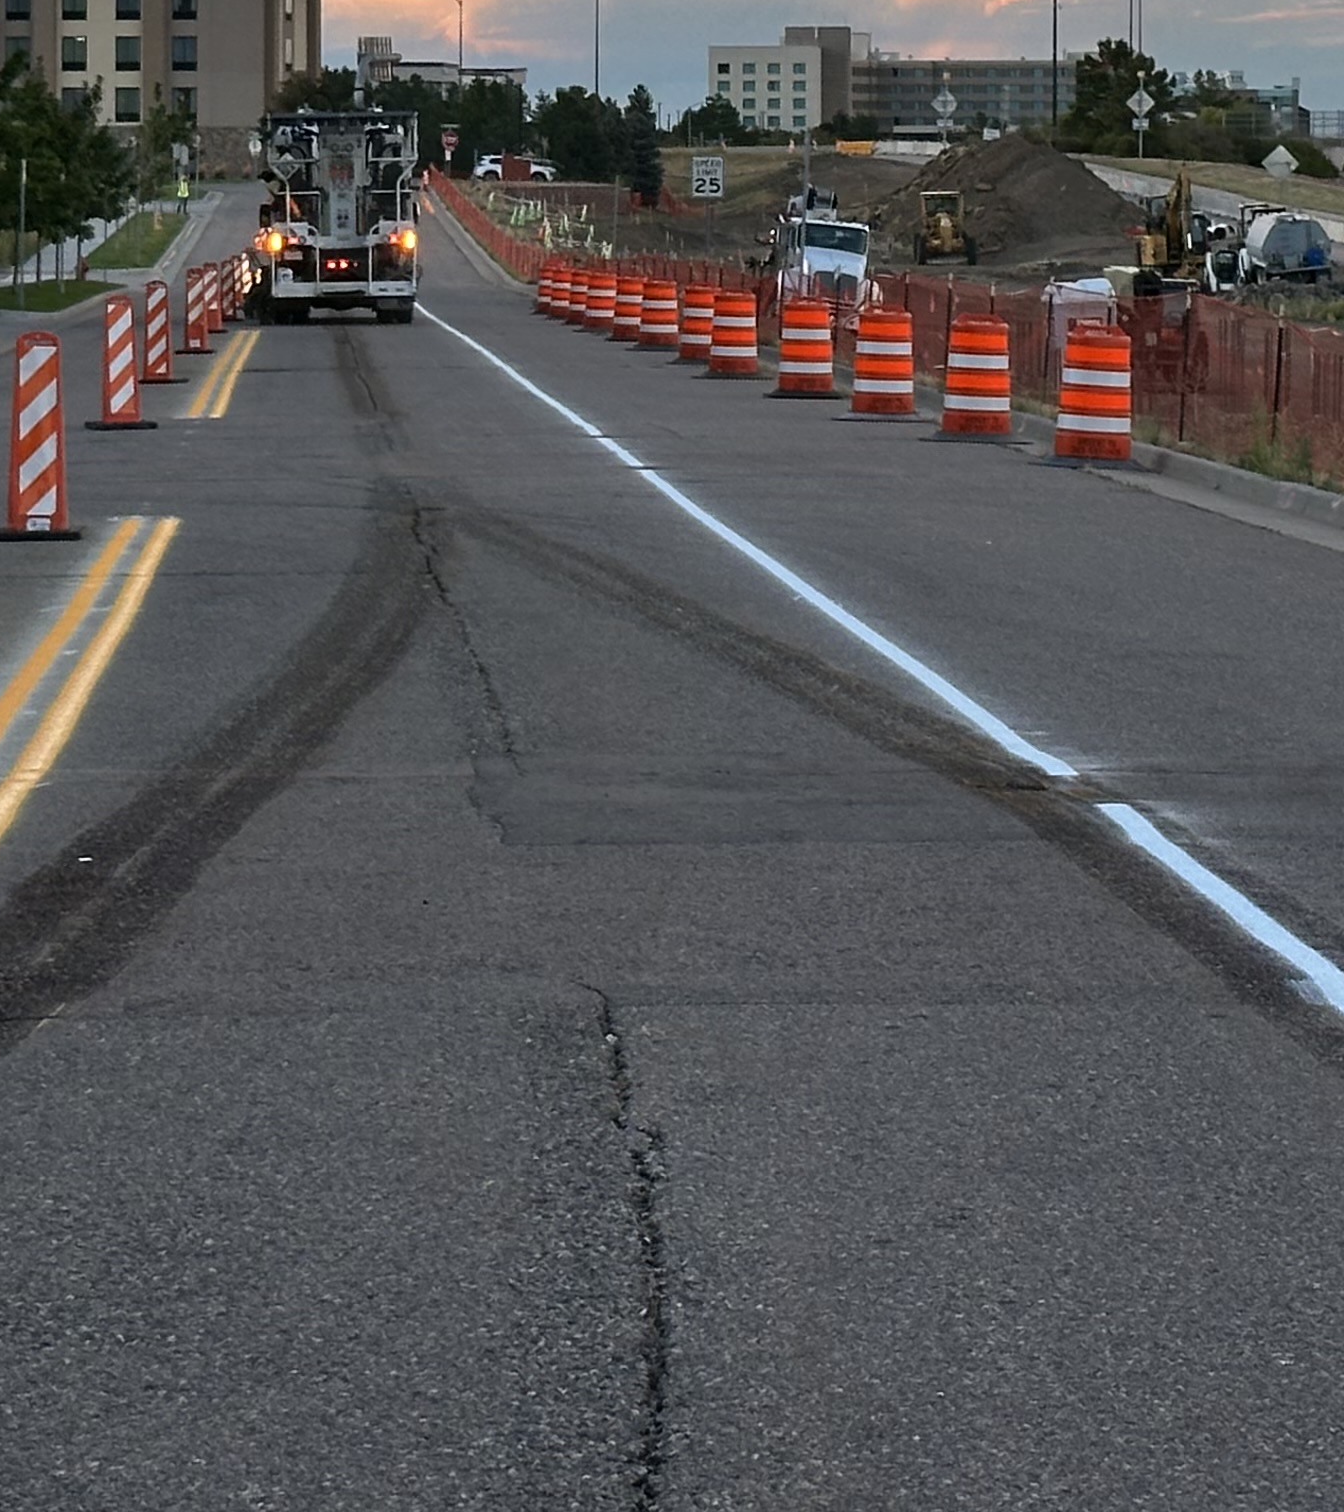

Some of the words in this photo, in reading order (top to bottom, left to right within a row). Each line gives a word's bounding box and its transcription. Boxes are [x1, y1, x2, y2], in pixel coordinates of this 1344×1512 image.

[694, 159, 722, 168] SPEED
[696, 168, 718, 176] LIMIT
[694, 178, 721, 194] 25
